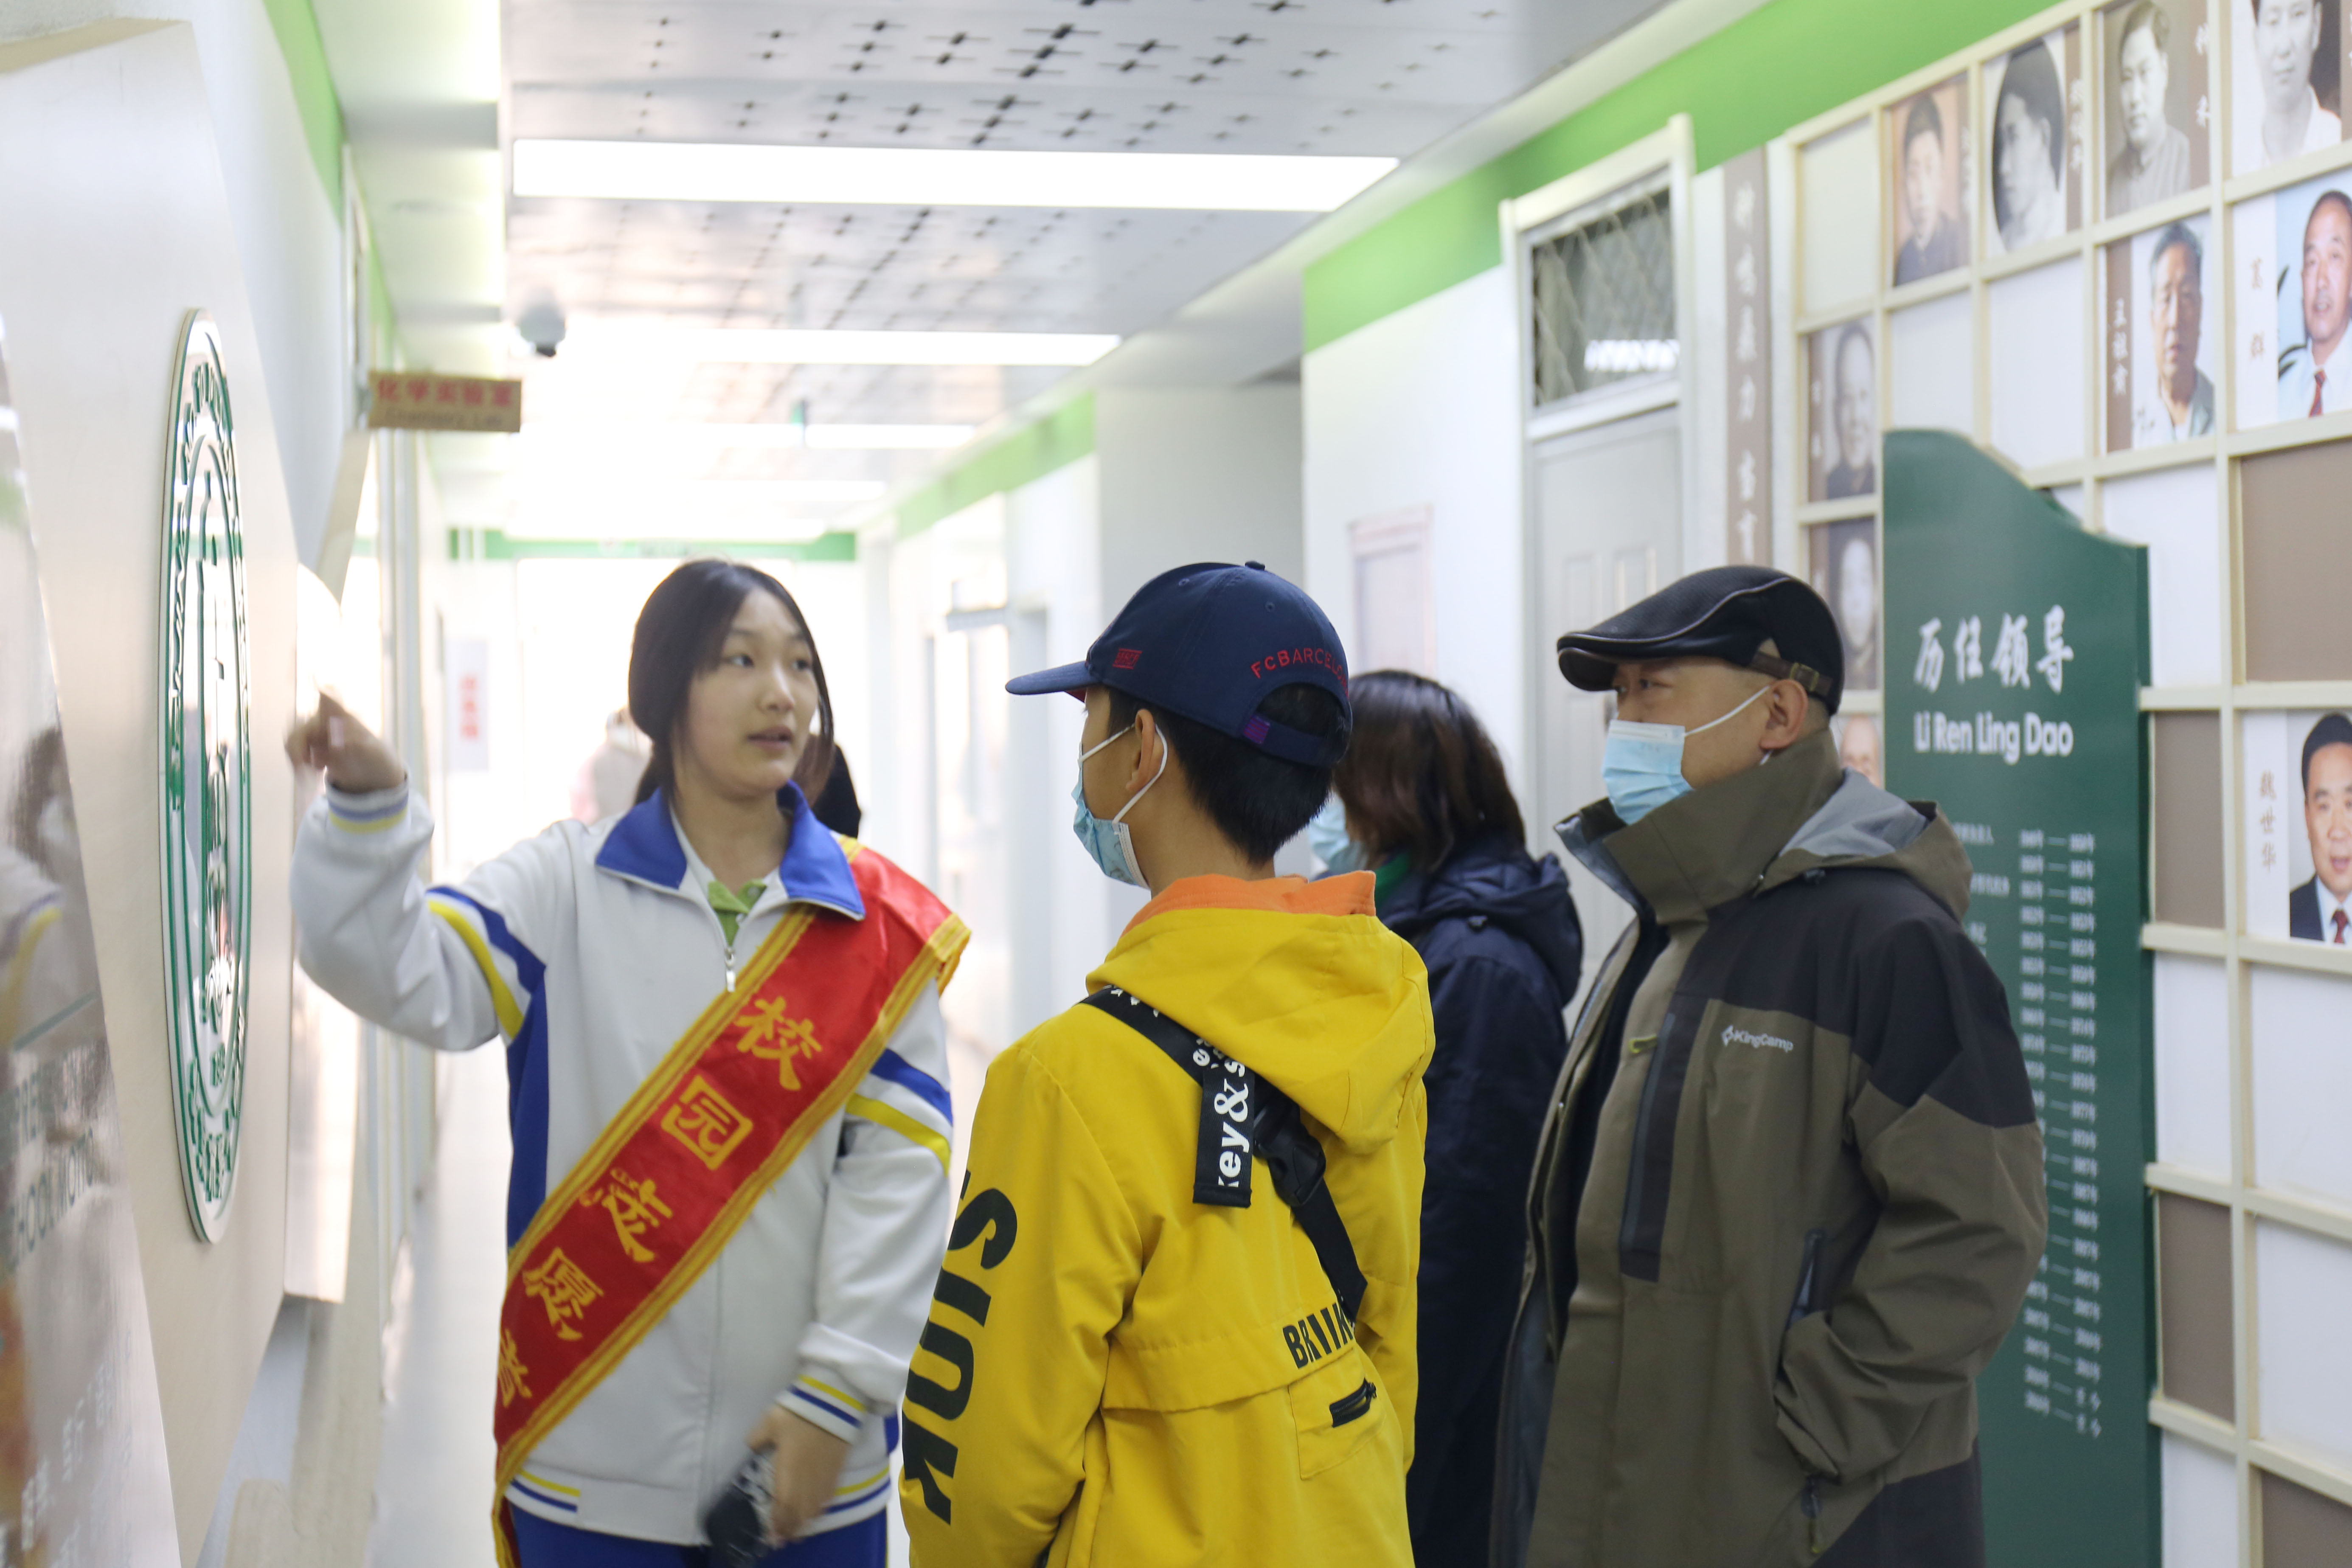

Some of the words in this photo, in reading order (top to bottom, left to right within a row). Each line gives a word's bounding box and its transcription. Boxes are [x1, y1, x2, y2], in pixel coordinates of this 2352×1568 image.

[1914, 604, 2074, 694] 历任领导
[1914, 711, 1931, 753] Li
[1933, 711, 1973, 754] Ren
[1976, 711, 2020, 765] Ling
[2023, 711, 2074, 757] Dao
[1734, 1029, 1794, 1053] KingCamp
